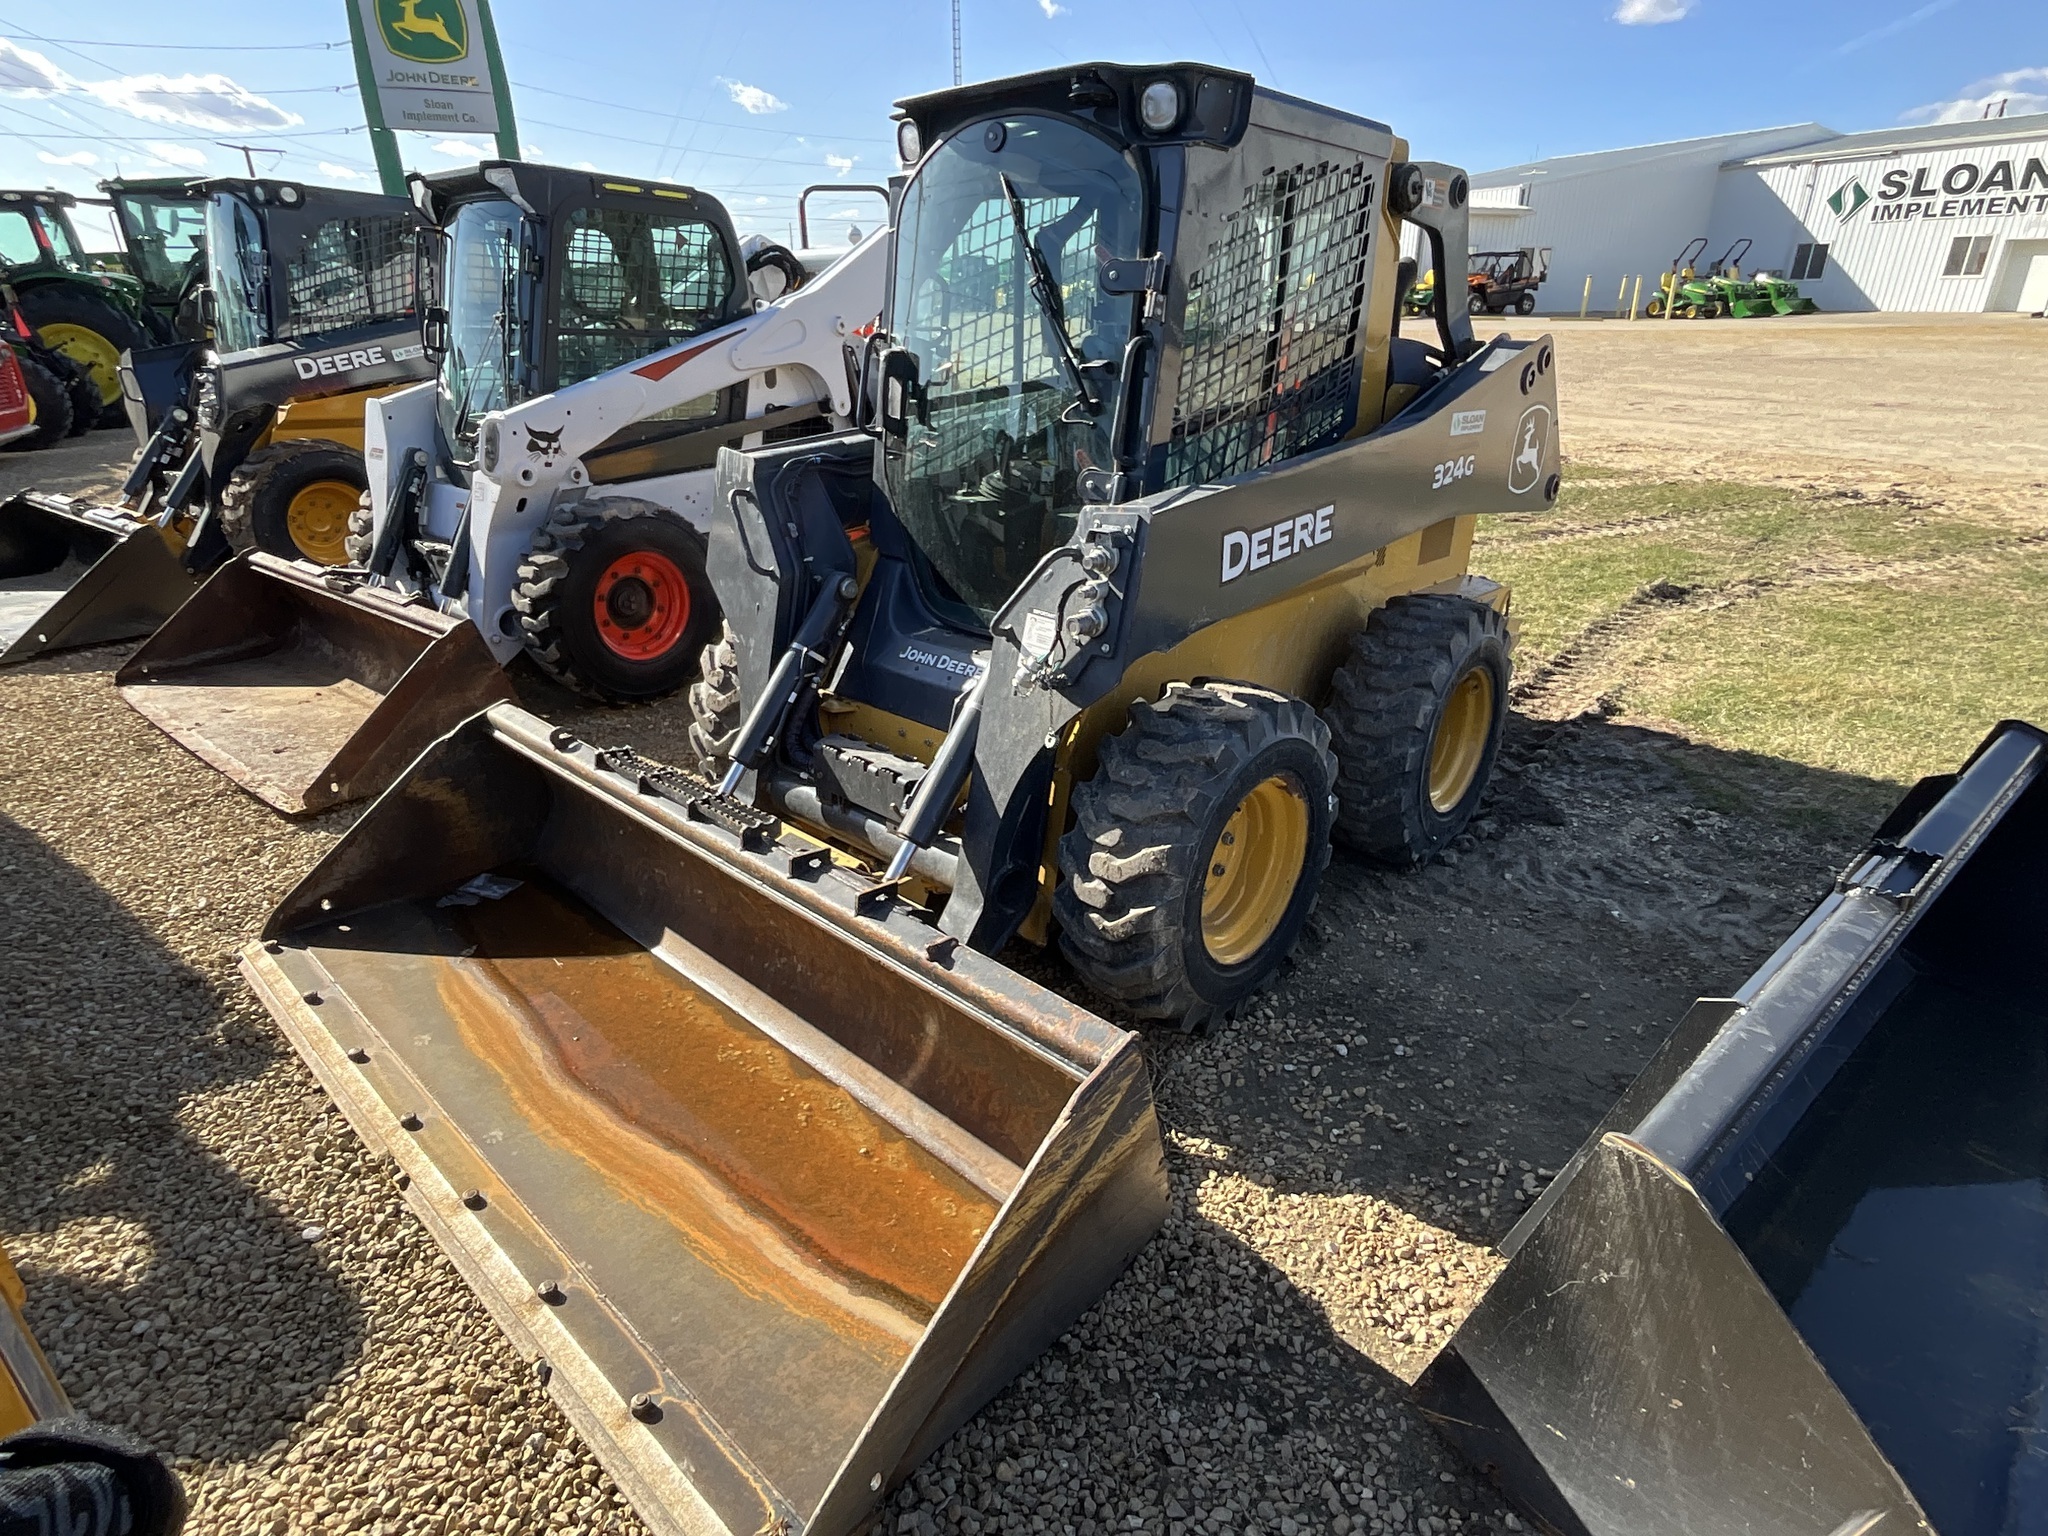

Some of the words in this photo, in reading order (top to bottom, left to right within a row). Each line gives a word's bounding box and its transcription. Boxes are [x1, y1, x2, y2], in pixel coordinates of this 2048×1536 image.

[386, 70, 426, 83] JOHN
[428, 71, 479, 87] DEERE
[424, 98, 453, 110] Sloan
[402, 110, 460, 123] Implement
[462, 113, 479, 123] Co.
[1877, 158, 2048, 200] SLOAN
[1870, 195, 2048, 222] IMPLEMENT
[294, 347, 386, 379] DEERE
[1461, 414, 1484, 424] SLOAN
[1432, 455, 1475, 489] 324G
[1222, 505, 1334, 582] DEERE
[899, 646, 937, 666] JOHN
